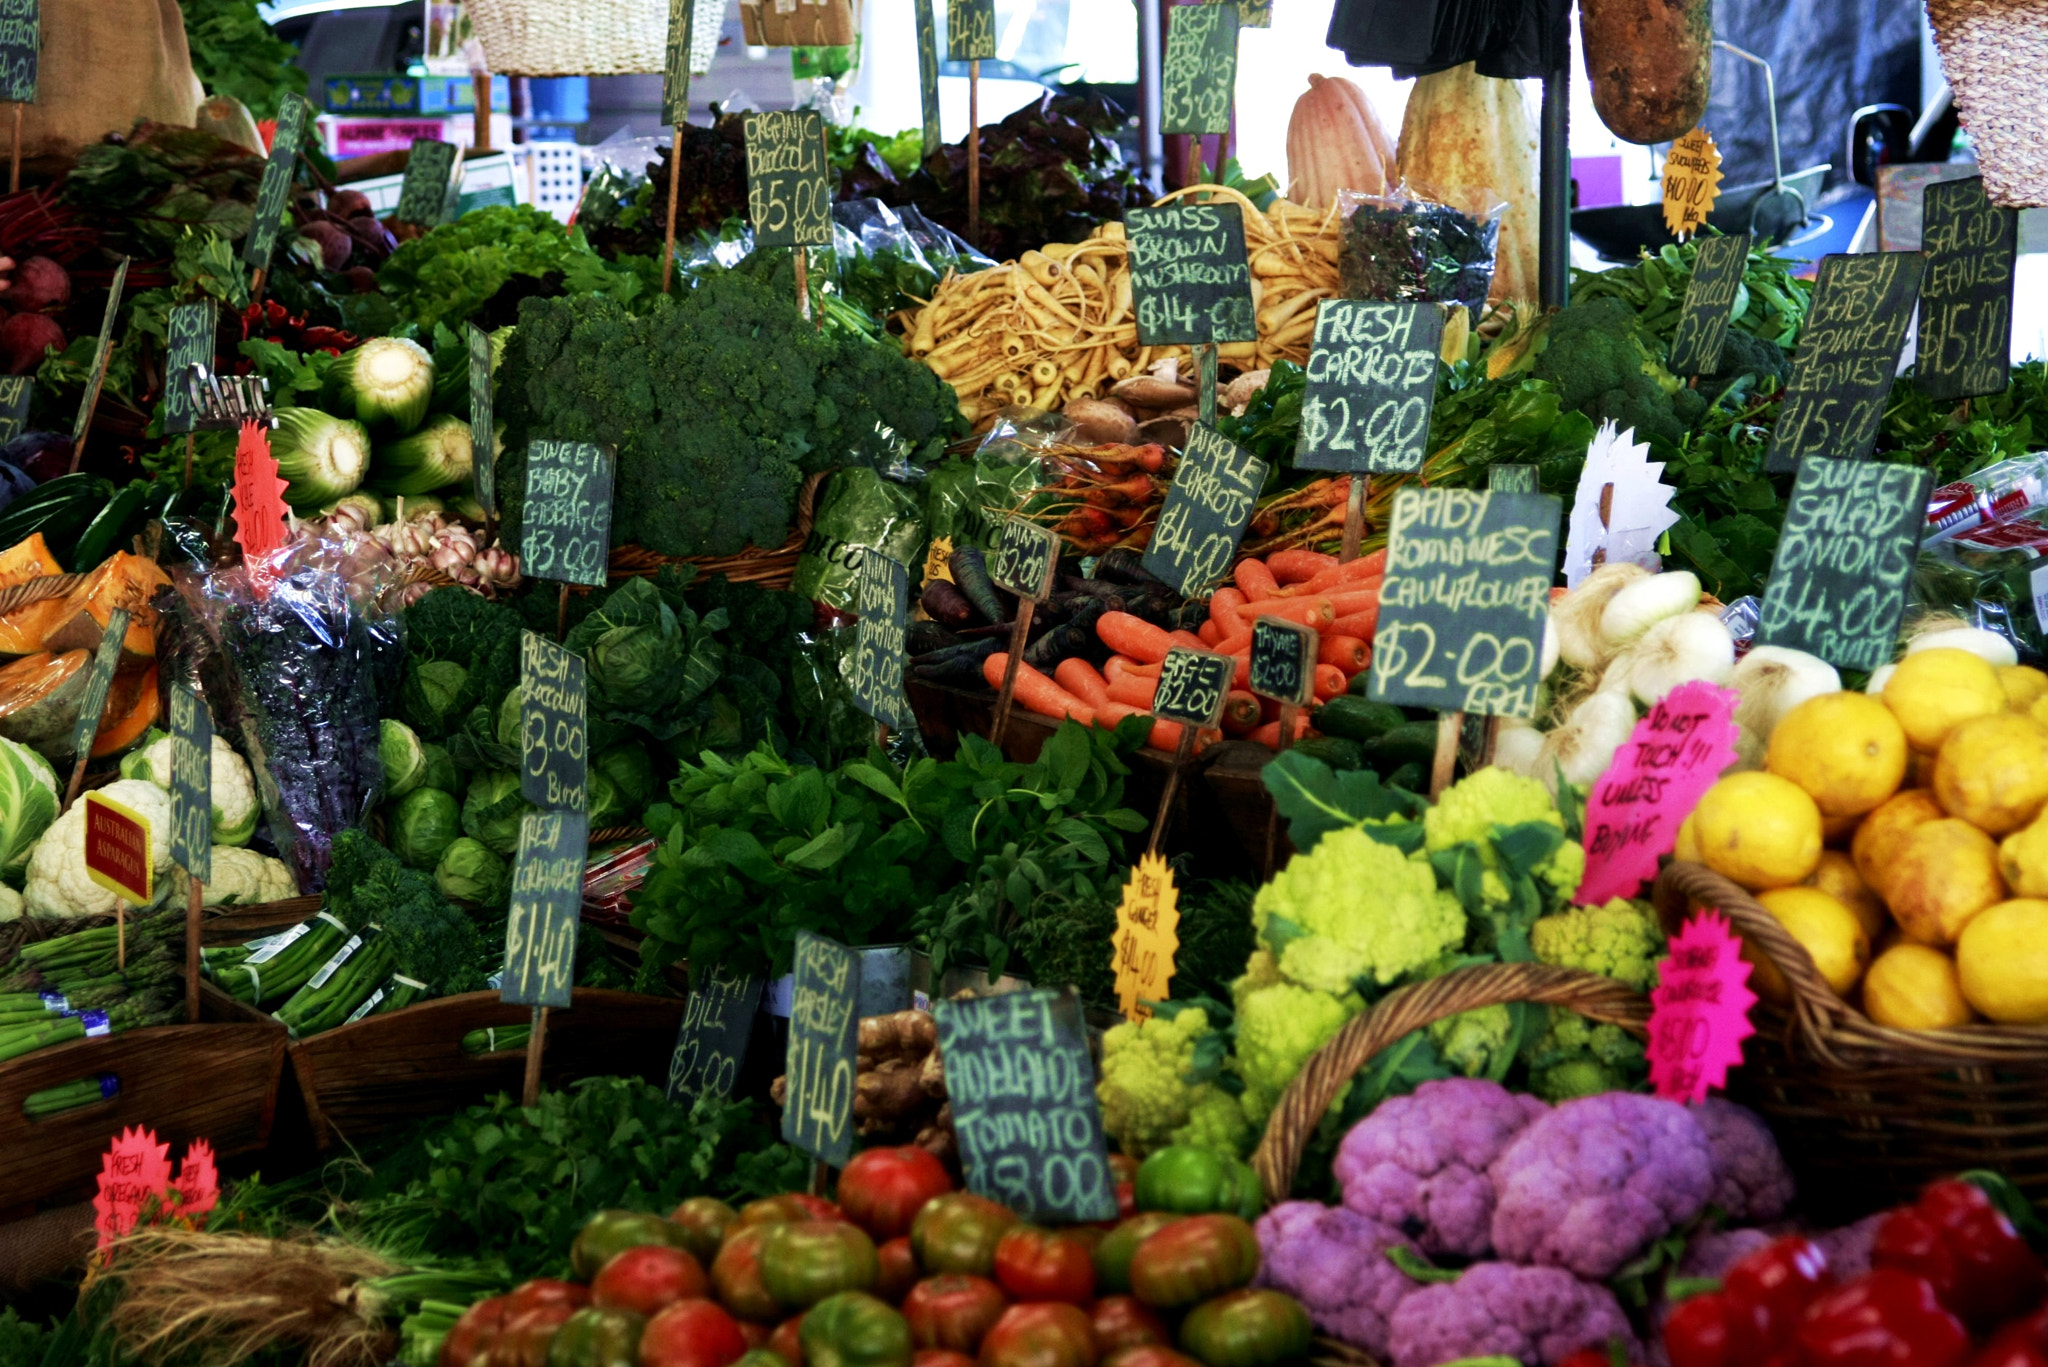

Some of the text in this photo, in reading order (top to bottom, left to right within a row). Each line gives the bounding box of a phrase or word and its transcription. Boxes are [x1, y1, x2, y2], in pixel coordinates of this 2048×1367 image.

[744, 111, 819, 144] ORGANIC
[1131, 231, 1228, 266] BROWN
[1924, 208, 2004, 259] SALAD
[1130, 261, 1249, 288] MUSHROOM
[1921, 250, 2011, 299] LEAVES
[167, 304, 211, 343] FRESH
[1315, 300, 1417, 351] FRESH
[1795, 312, 1910, 368] SPINACH
[1306, 344, 1436, 391] CARROTS
[1786, 355, 1893, 393] LEAVES
[529, 439, 607, 477] SWEET
[1179, 421, 1262, 491] PURPLE
[527, 466, 589, 510] BABY
[1175, 459, 1254, 528] CARROTS
[1799, 456, 1928, 511] SWEET
[522, 500, 609, 535] CABBAGE
[1390, 487, 1492, 540] BABY
[1787, 488, 1905, 539] SALAD
[1004, 521, 1046, 560] MINT
[1778, 536, 1915, 589] ONIONS
[1378, 570, 1550, 621] CAULIFLOWER
[521, 633, 570, 684] FRESH
[1255, 625, 1300, 658] THYME
[1161, 652, 1221, 688] SAGE
[94, 813, 142, 854] AUSTRALIAN
[96, 838, 140, 878] ASPARAGUS
[934, 990, 1060, 1051] SWEET
[946, 1041, 1093, 1106] ADELAIDE
[954, 1107, 1093, 1158] TOMATO
[111, 1150, 144, 1178] FRESH
